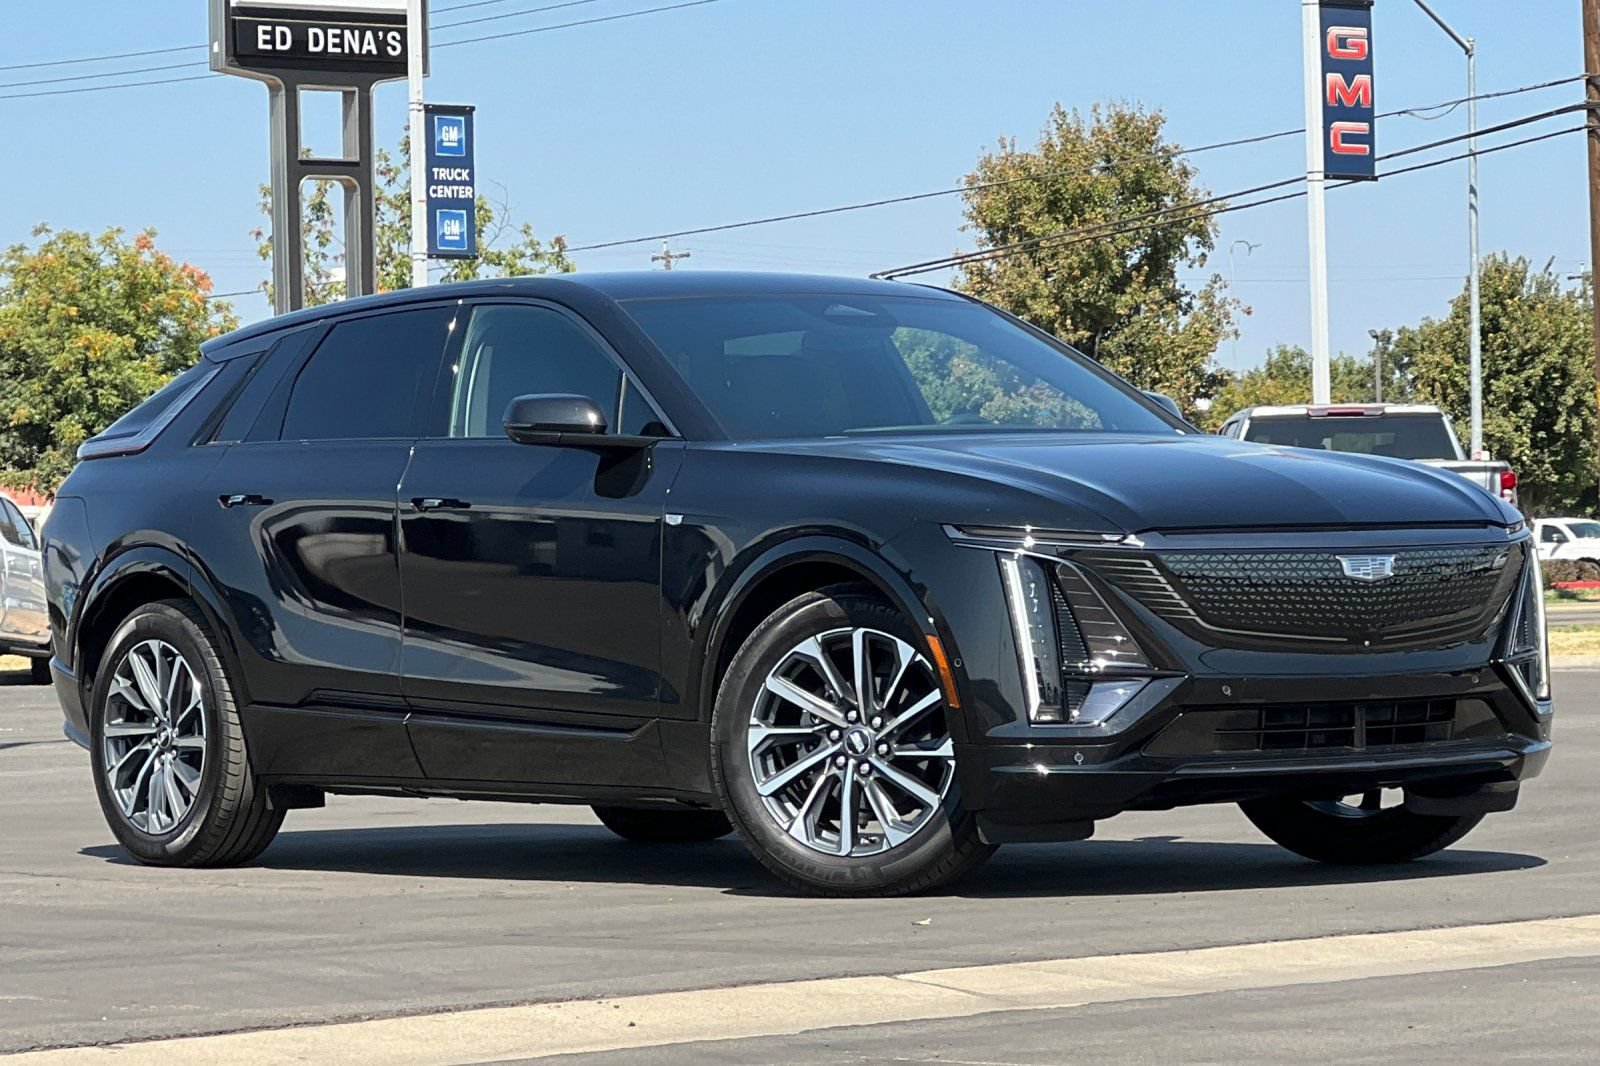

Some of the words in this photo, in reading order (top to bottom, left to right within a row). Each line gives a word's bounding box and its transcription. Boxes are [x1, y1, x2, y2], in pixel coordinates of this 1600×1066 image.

[257, 25, 292, 50] ED
[308, 28, 402, 56] DENA'S
[1326, 26, 1372, 155] GMC
[441, 125, 458, 143] GM
[432, 167, 470, 181] TRUCK
[429, 185, 473, 199] CENTER
[443, 219, 460, 237] GM
